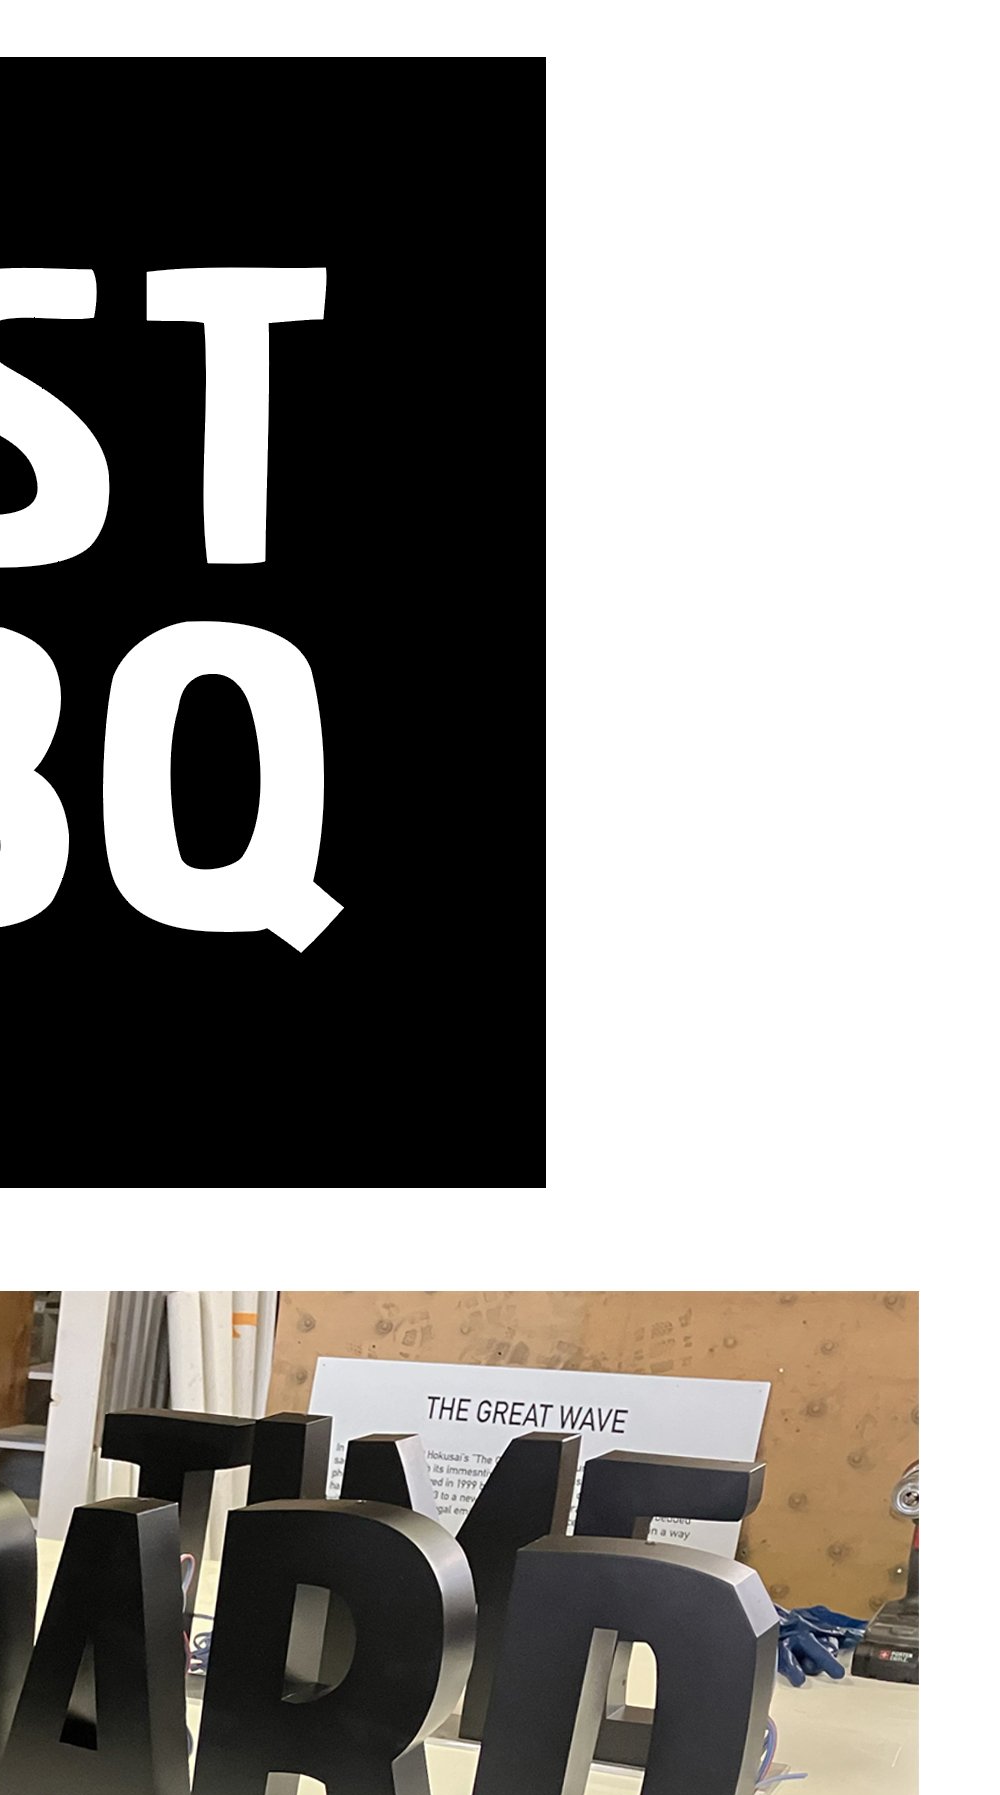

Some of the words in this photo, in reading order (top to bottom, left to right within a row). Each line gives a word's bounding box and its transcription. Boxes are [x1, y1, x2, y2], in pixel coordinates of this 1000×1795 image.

[427, 1396, 471, 1422] THE
[476, 1400, 554, 1428] GREAT
[560, 1404, 629, 1434] WAVE
[457, 1479, 478, 1490] 1999
[669, 1529, 691, 1541] way
